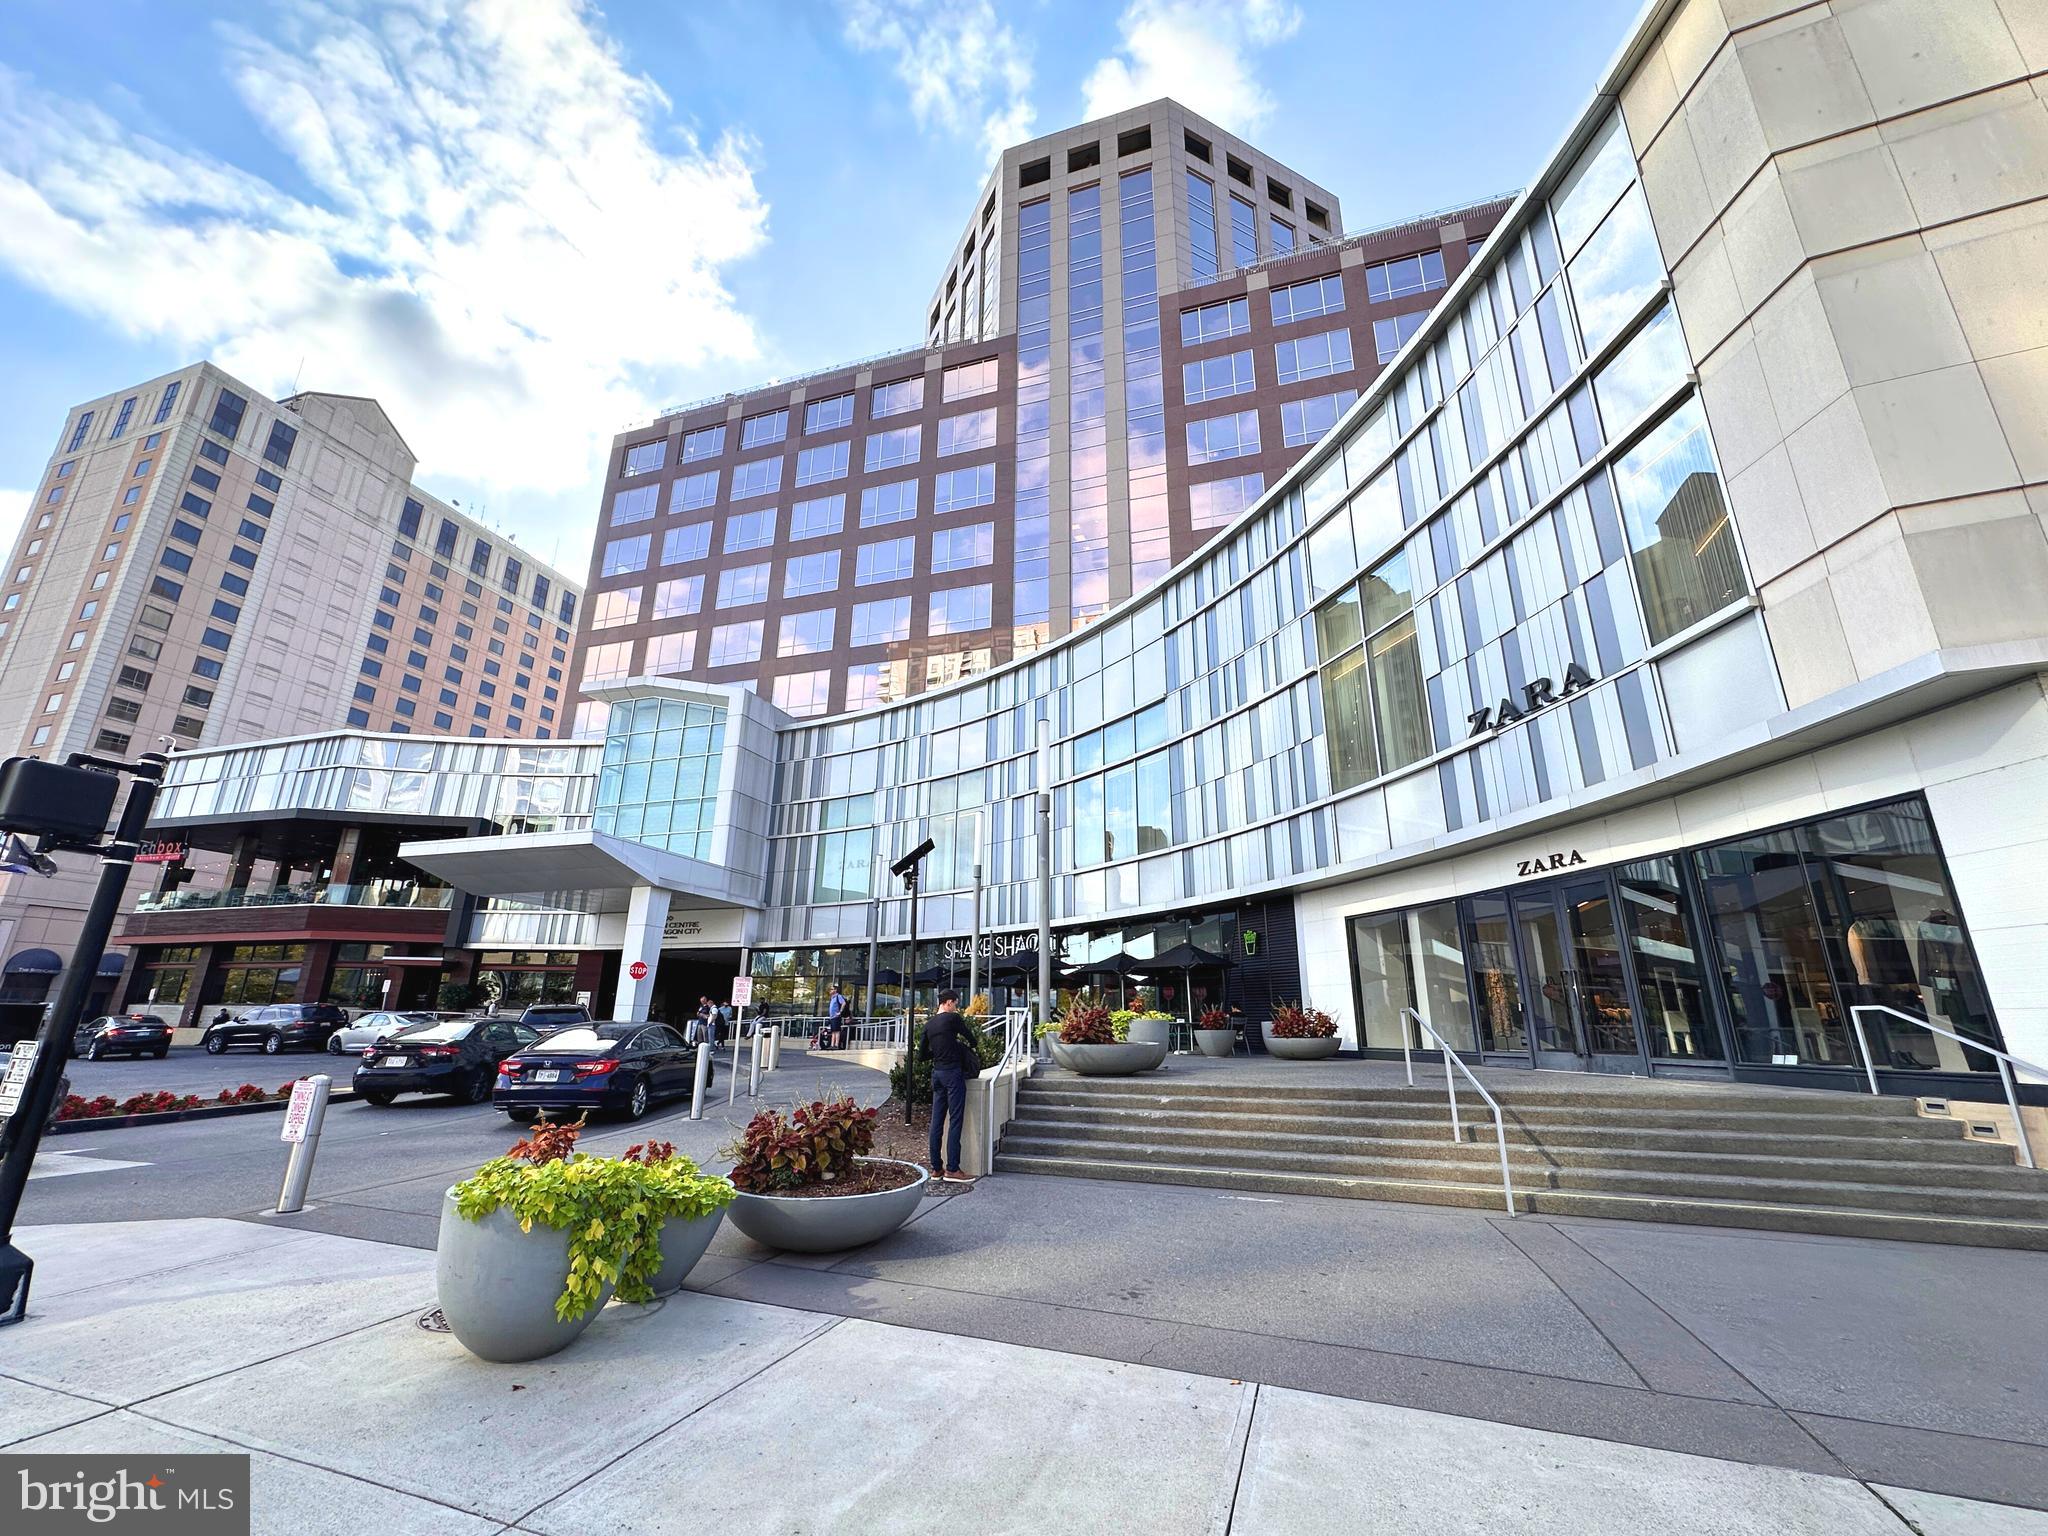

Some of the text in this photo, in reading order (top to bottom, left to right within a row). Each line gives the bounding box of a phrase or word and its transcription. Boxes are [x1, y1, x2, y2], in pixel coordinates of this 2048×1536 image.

[1467, 662, 1595, 738] ZARA
[1516, 849, 1586, 876] ZARA
[669, 921, 700, 929] CENTRE
[944, 933, 1045, 959] SHAKE SHAC
[630, 966, 647, 975] STOP
